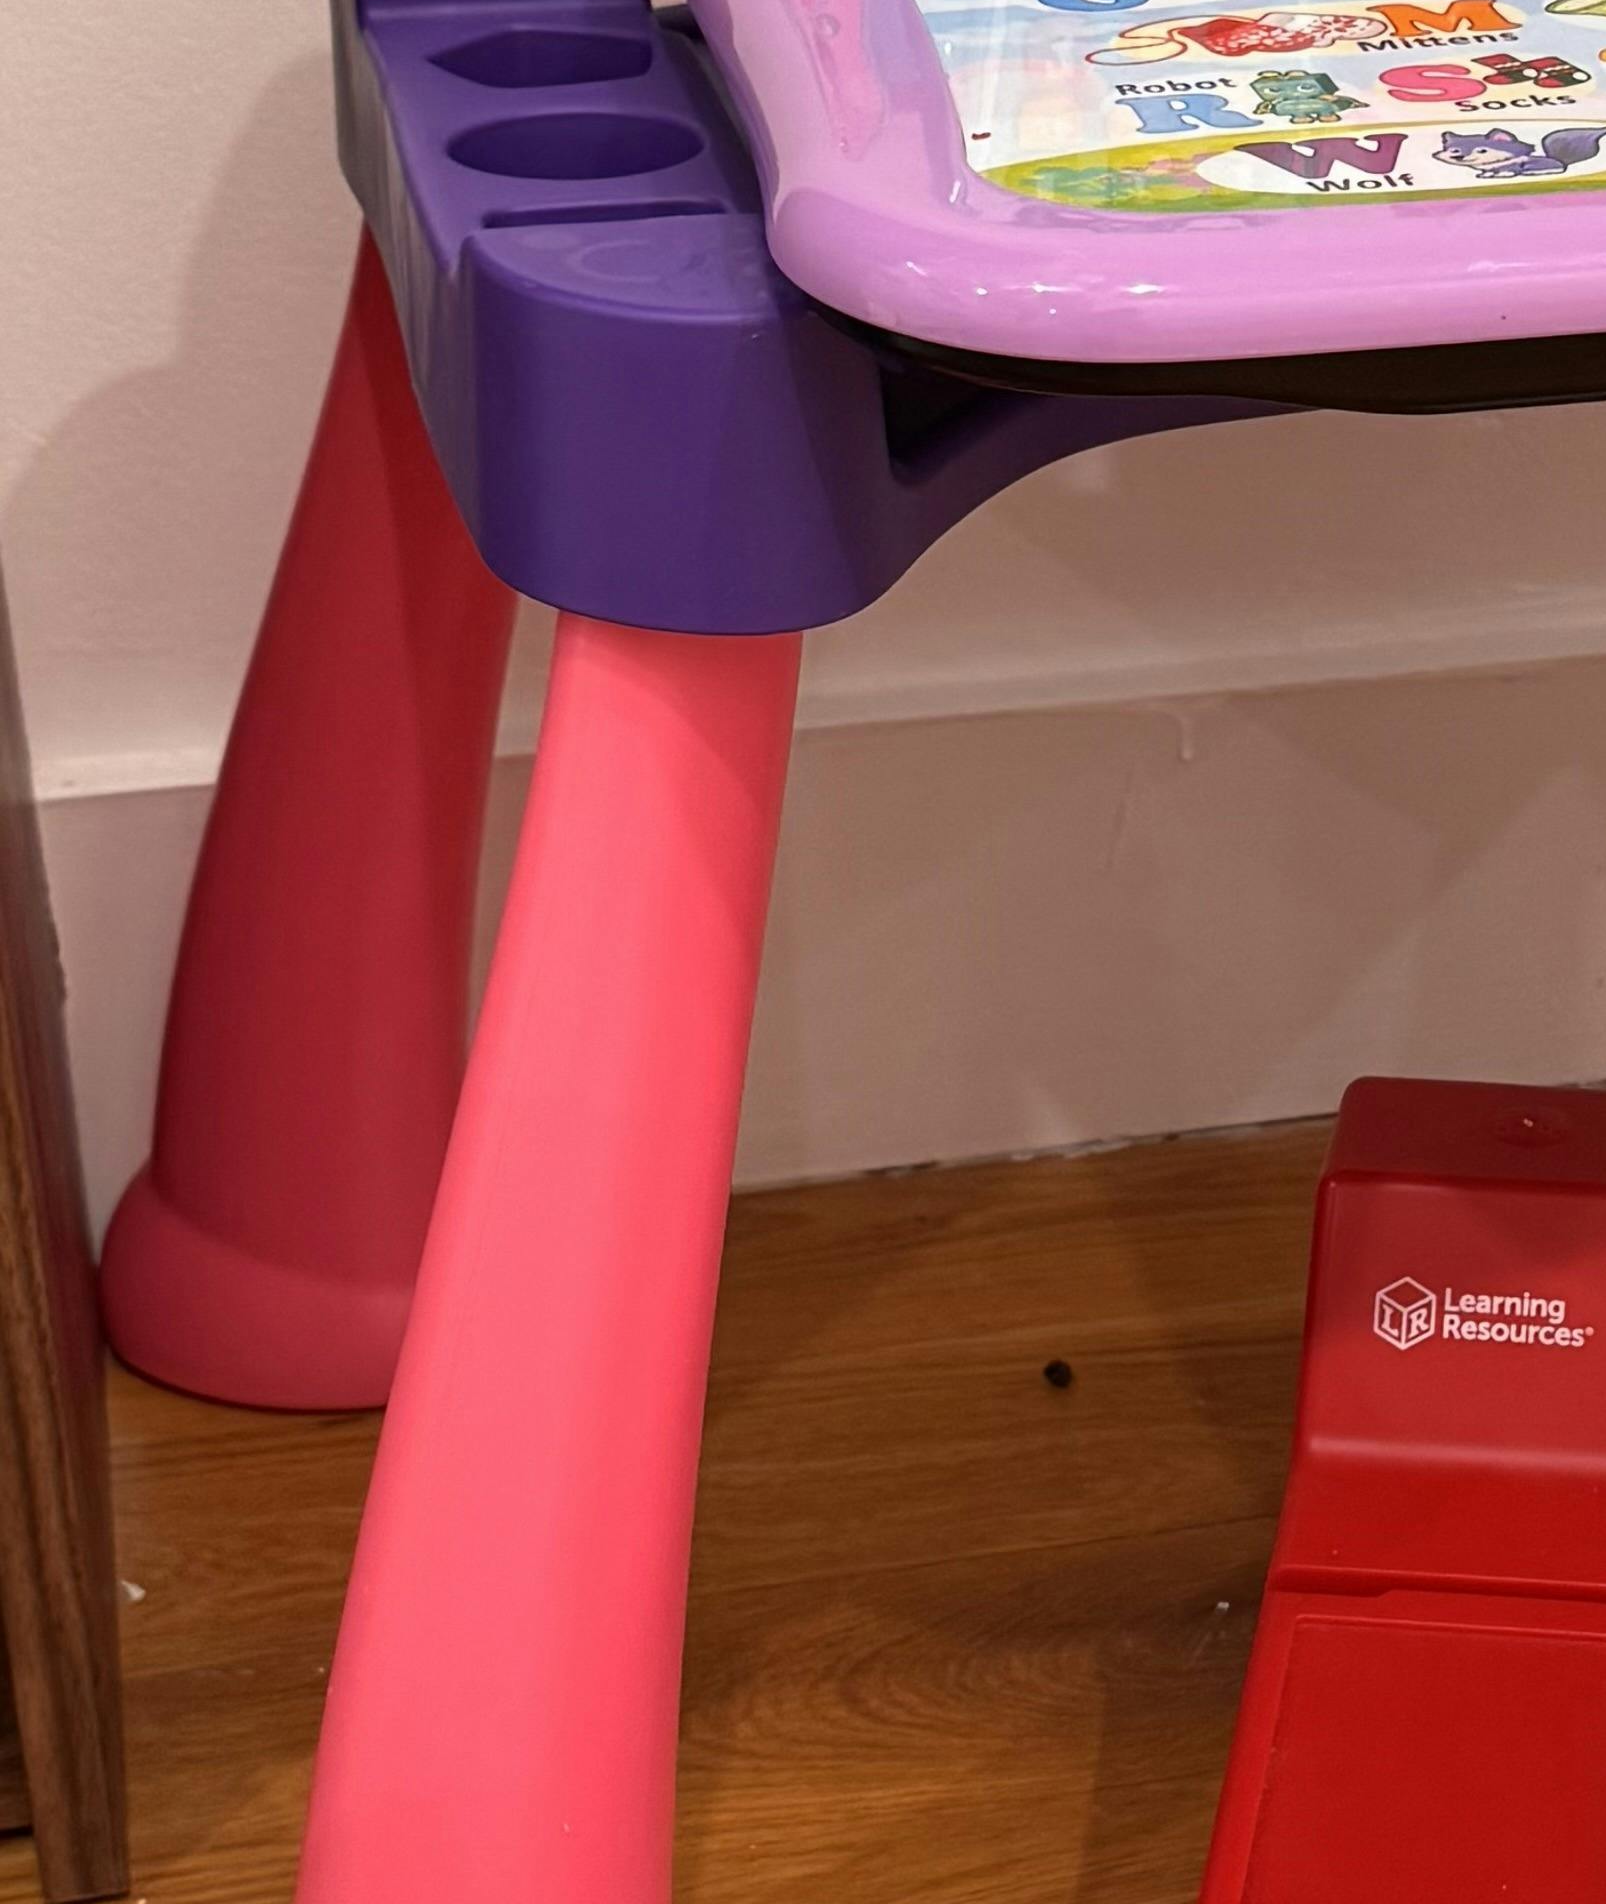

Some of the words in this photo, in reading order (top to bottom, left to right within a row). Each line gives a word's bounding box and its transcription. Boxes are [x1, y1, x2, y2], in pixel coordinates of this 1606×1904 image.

[1357, 32, 1518, 52] Mittens
[1116, 78, 1238, 95] Robot
[1379, 64, 1487, 102] S
[1115, 94, 1264, 133] R
[1455, 95, 1576, 112] Socks
[1233, 133, 1408, 179] W
[1307, 173, 1414, 192] Wolf
[1445, 1287, 1566, 1324] Learning
